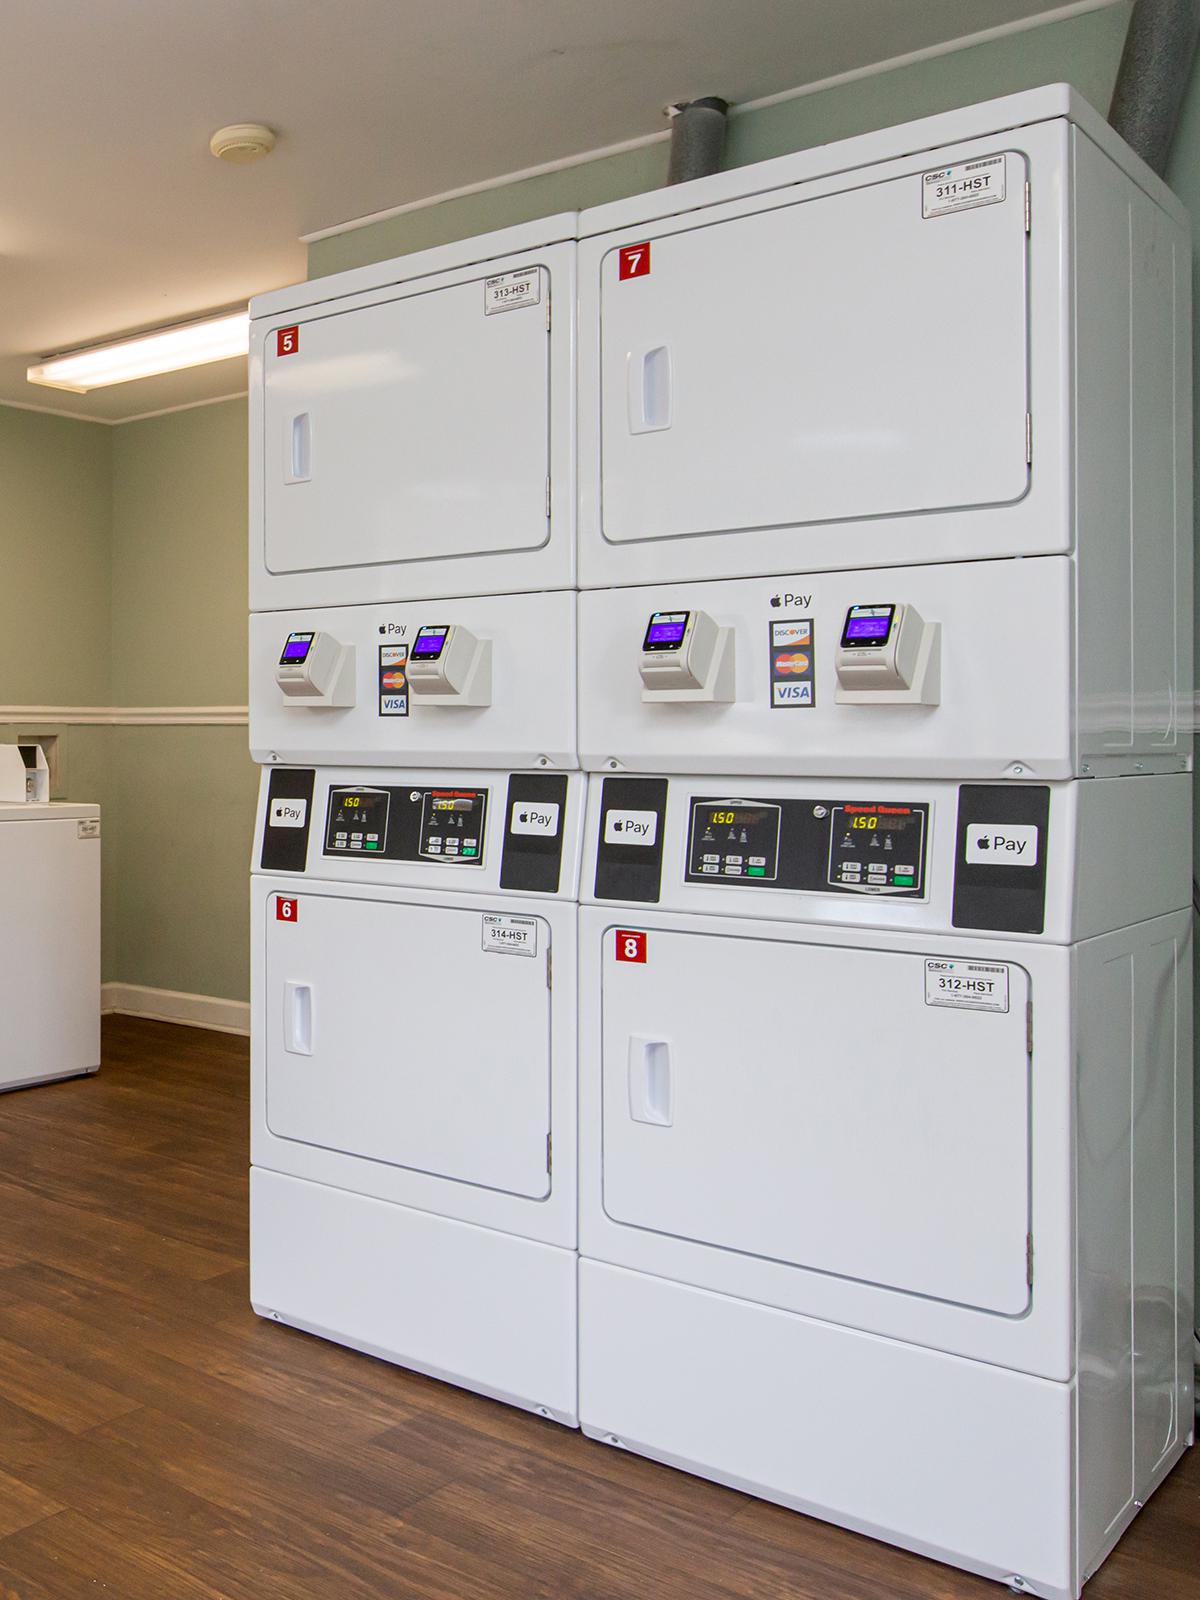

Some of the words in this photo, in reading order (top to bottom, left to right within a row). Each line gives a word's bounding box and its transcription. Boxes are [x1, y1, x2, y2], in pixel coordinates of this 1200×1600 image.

[925, 171, 945, 182] CSC
[936, 175, 991, 198] 311-HST
[628, 253, 642, 274] 7
[494, 283, 531, 299] 313-HST
[283, 335, 293, 352] 5
[784, 593, 812, 609] Pay
[388, 623, 407, 636] Pay
[774, 628, 809, 637] DISCOVER
[778, 686, 810, 699] VISA
[383, 699, 405, 709] VISA
[283, 806, 301, 820] Pay
[844, 804, 876, 814] Speed
[877, 805, 911, 814] Queen
[530, 812, 552, 826] Pay
[625, 820, 650, 836] Pay
[994, 836, 1027, 855] Pay
[282, 902, 291, 918] 6
[491, 928, 528, 941] 314-HST
[625, 938, 638, 958] 8
[927, 962, 948, 970] CSC
[938, 977, 995, 992] 312-HST
